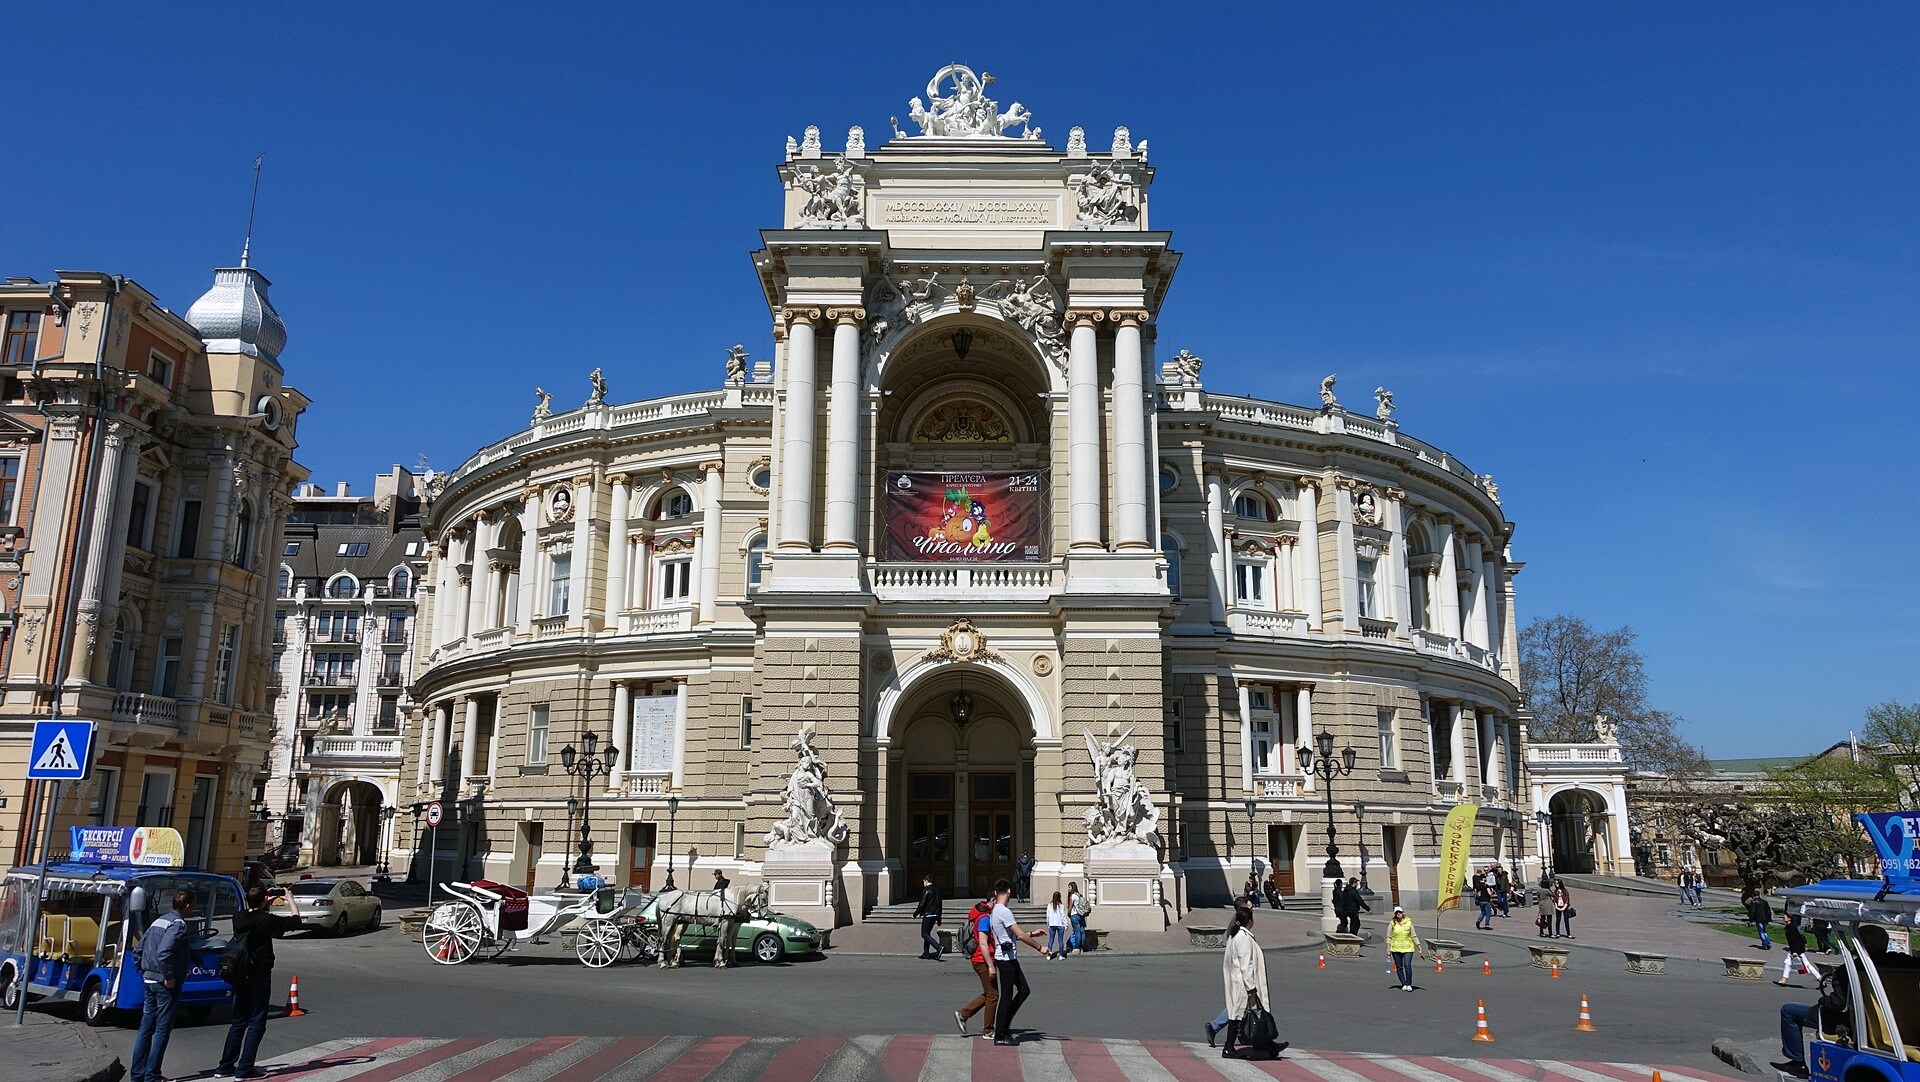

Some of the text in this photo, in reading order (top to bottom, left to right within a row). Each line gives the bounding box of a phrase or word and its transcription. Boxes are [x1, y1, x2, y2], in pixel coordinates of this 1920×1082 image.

[1008, 476, 1038, 486] 21-24
[83, 829, 124, 842] ЕКСКУРСІЇ
[156, 856, 171, 864] TOURS
[1880, 858, 1920, 871] (095) 482
